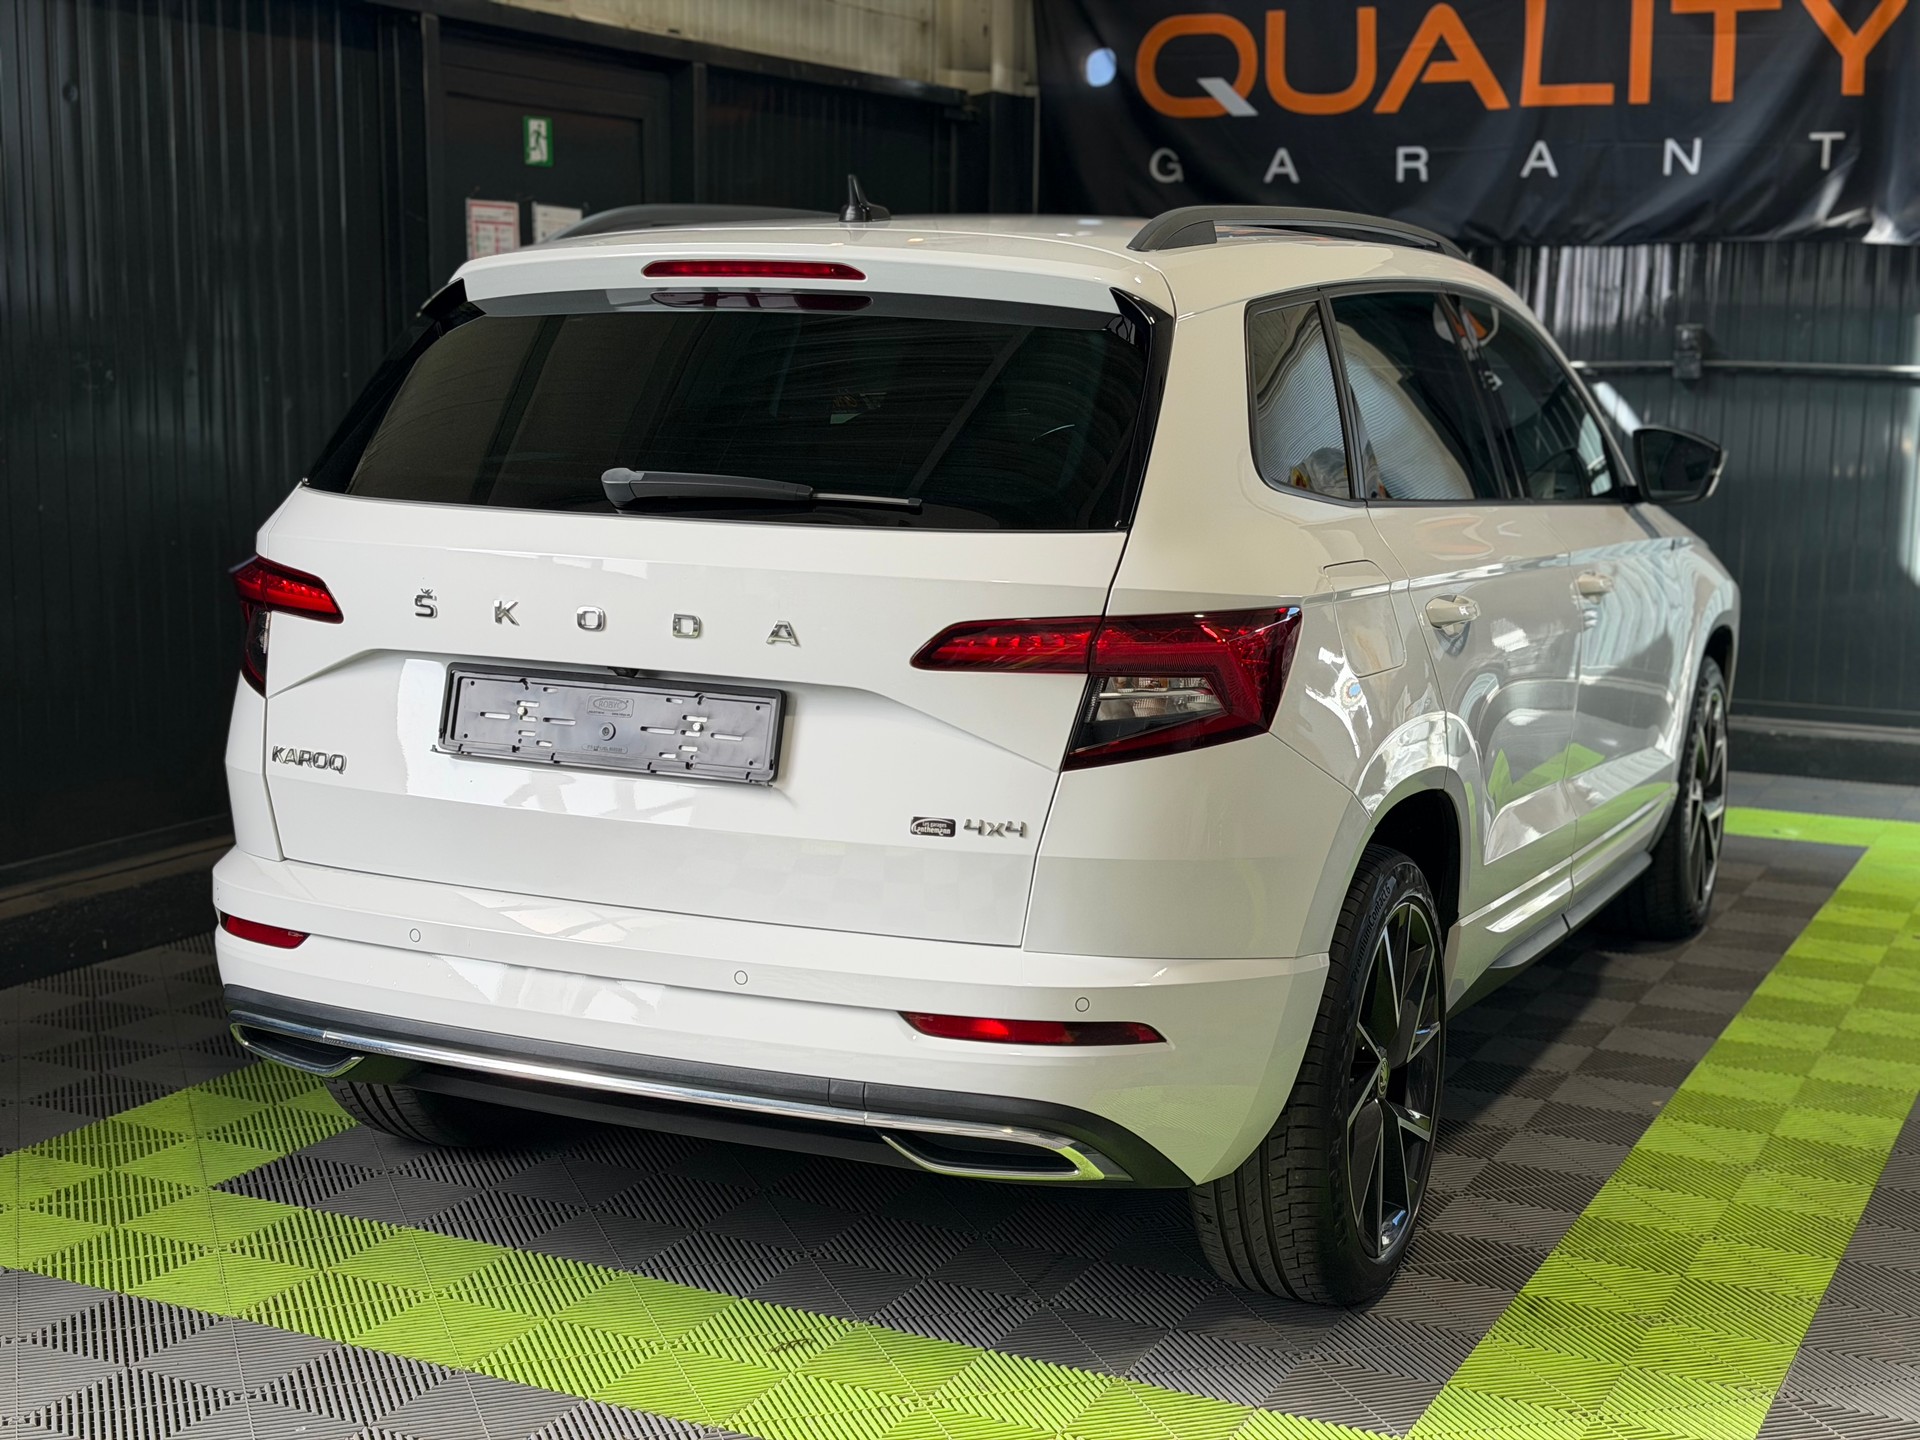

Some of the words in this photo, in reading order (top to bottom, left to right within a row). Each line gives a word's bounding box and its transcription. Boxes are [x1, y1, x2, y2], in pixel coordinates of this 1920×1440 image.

[1134, 0, 1908, 118] QUALITY
[1149, 131, 1855, 184] GARANT
[414, 587, 800, 647] ŠKODA
[271, 744, 348, 775] KAROQ
